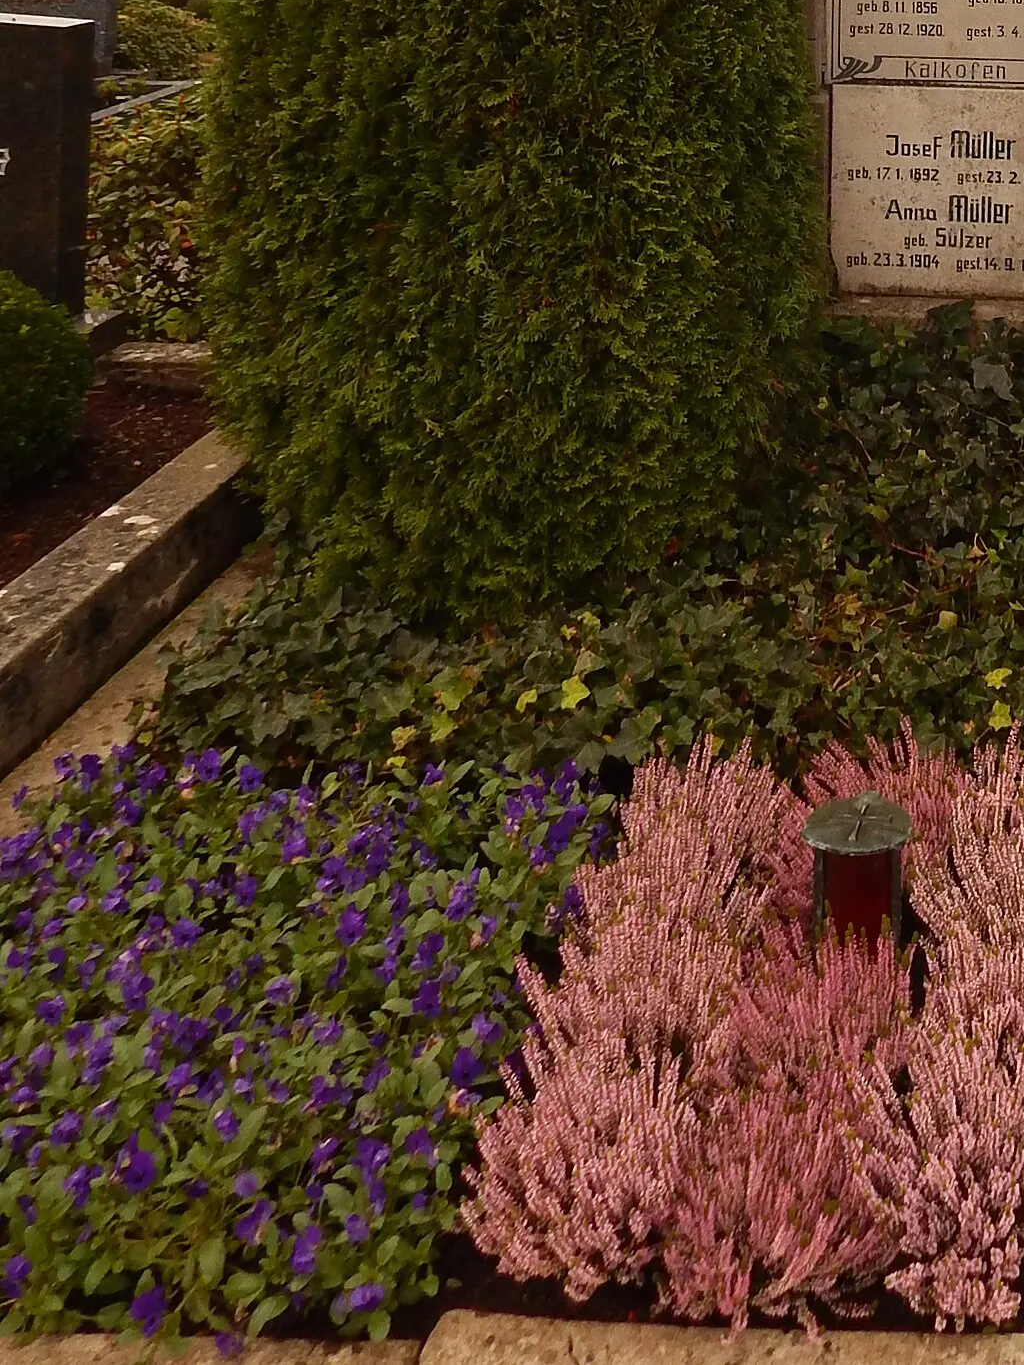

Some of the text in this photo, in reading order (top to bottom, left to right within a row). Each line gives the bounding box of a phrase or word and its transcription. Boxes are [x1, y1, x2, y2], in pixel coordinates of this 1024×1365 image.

[913, 2, 937, 14] 1856
[906, 61, 1006, 79] Kalkofen
[951, 130, 1016, 160] Müller
[910, 169, 939, 182] 1892
[885, 195, 1013, 224] Anna Müller
[904, 228, 992, 249] geb. Sülzer
